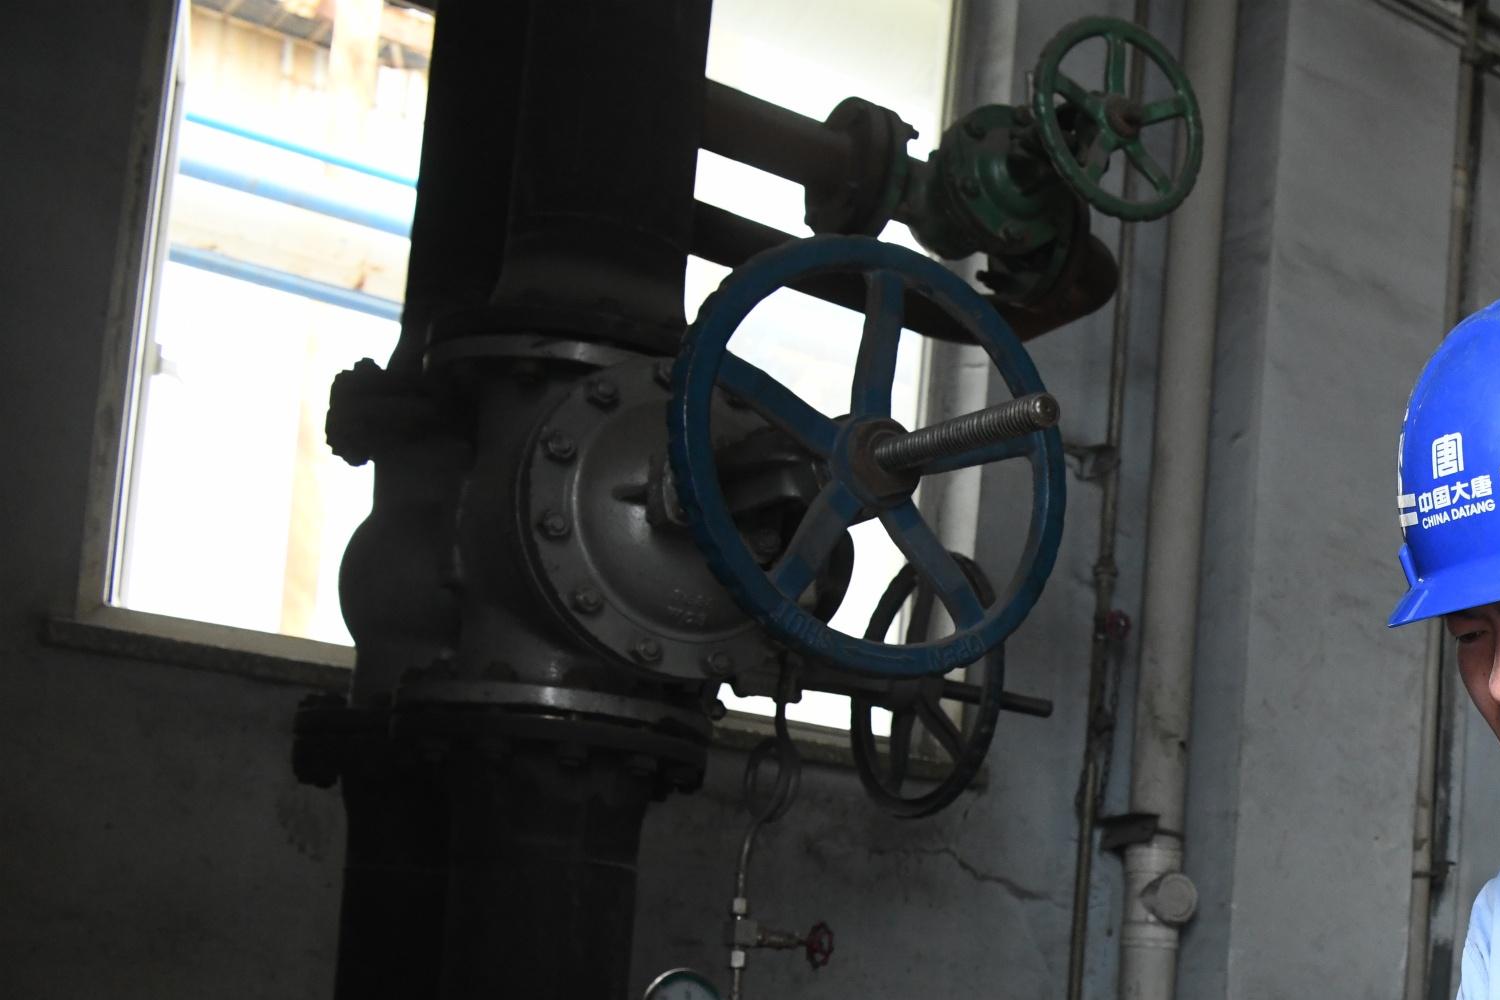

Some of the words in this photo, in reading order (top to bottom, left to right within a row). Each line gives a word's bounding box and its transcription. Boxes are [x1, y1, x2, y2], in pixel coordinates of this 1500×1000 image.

[1419, 475, 1492, 512] 中国大唐
[1422, 511, 1450, 529] CHINA
[1451, 499, 1495, 520] DATANG
